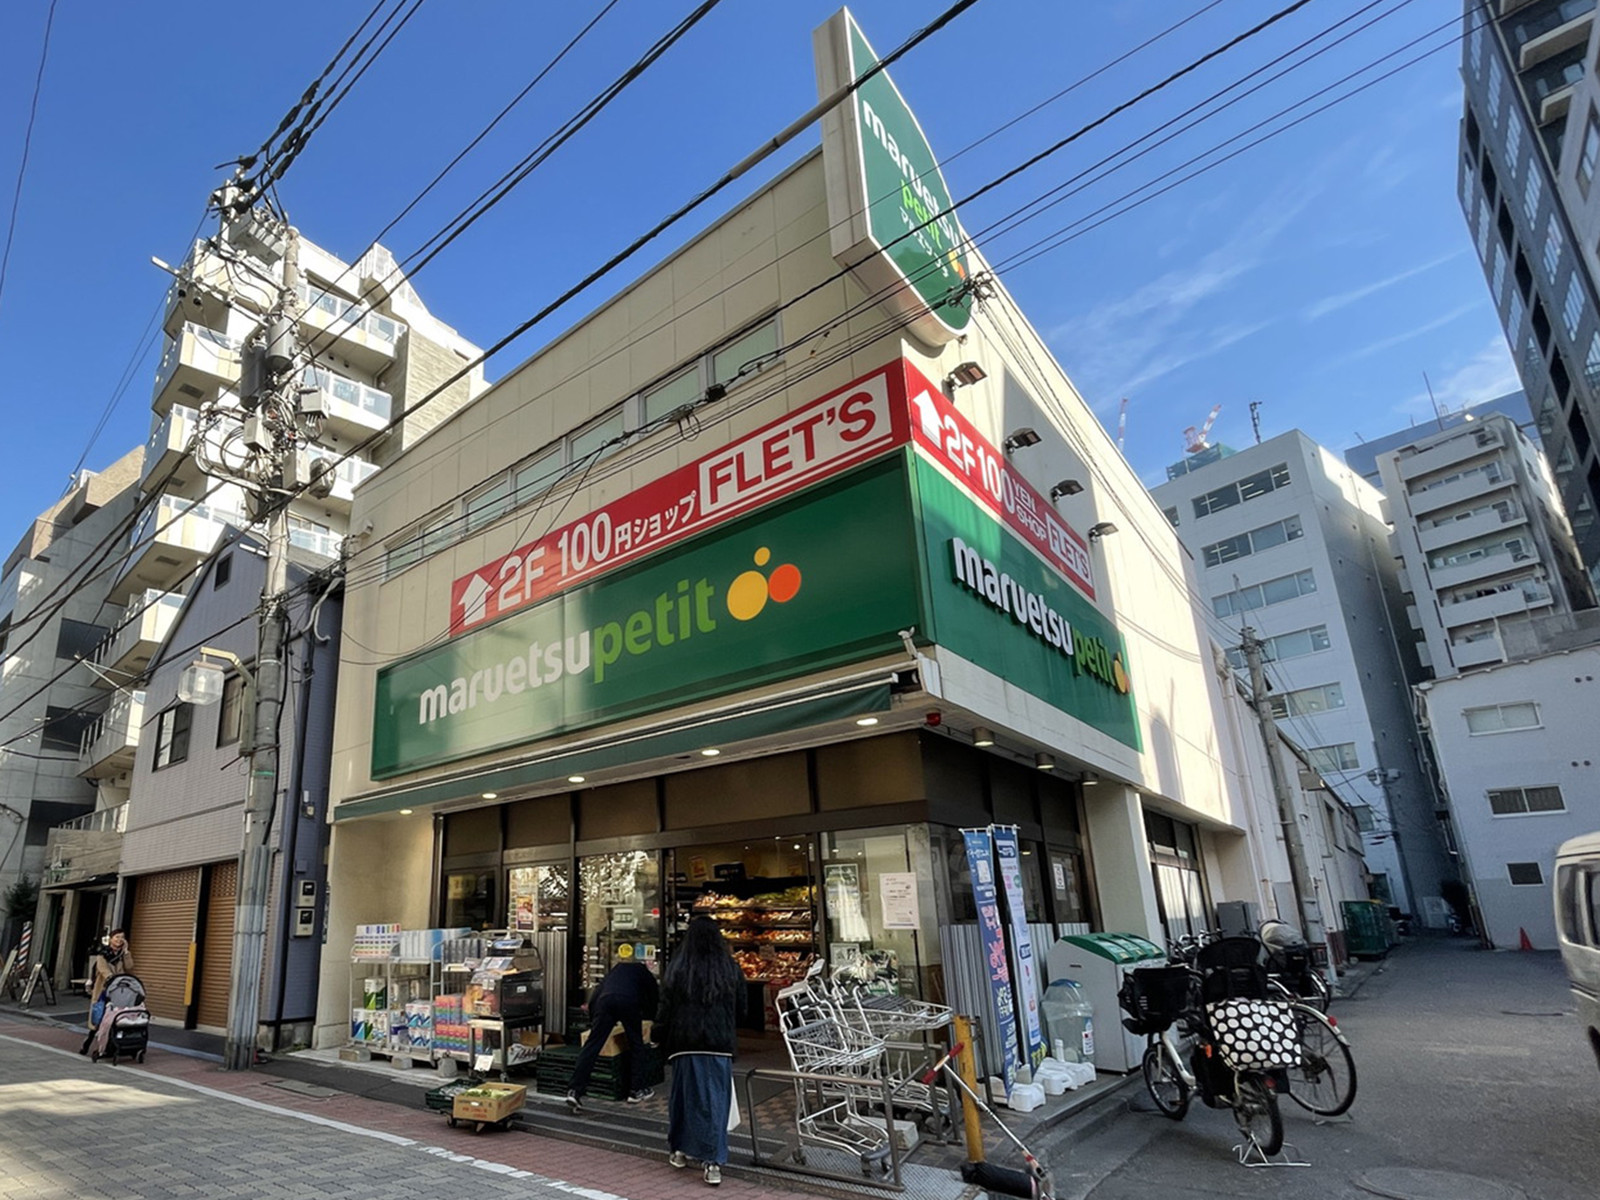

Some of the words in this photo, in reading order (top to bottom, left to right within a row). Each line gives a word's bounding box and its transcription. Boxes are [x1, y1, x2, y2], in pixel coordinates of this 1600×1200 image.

[861, 99, 962, 256] maruetsu
[901, 178, 943, 251] petit
[498, 547, 548, 612] 2F
[707, 391, 877, 507] FLET'S
[1012, 478, 1037, 513] YEN
[1015, 504, 1047, 541] SHOP
